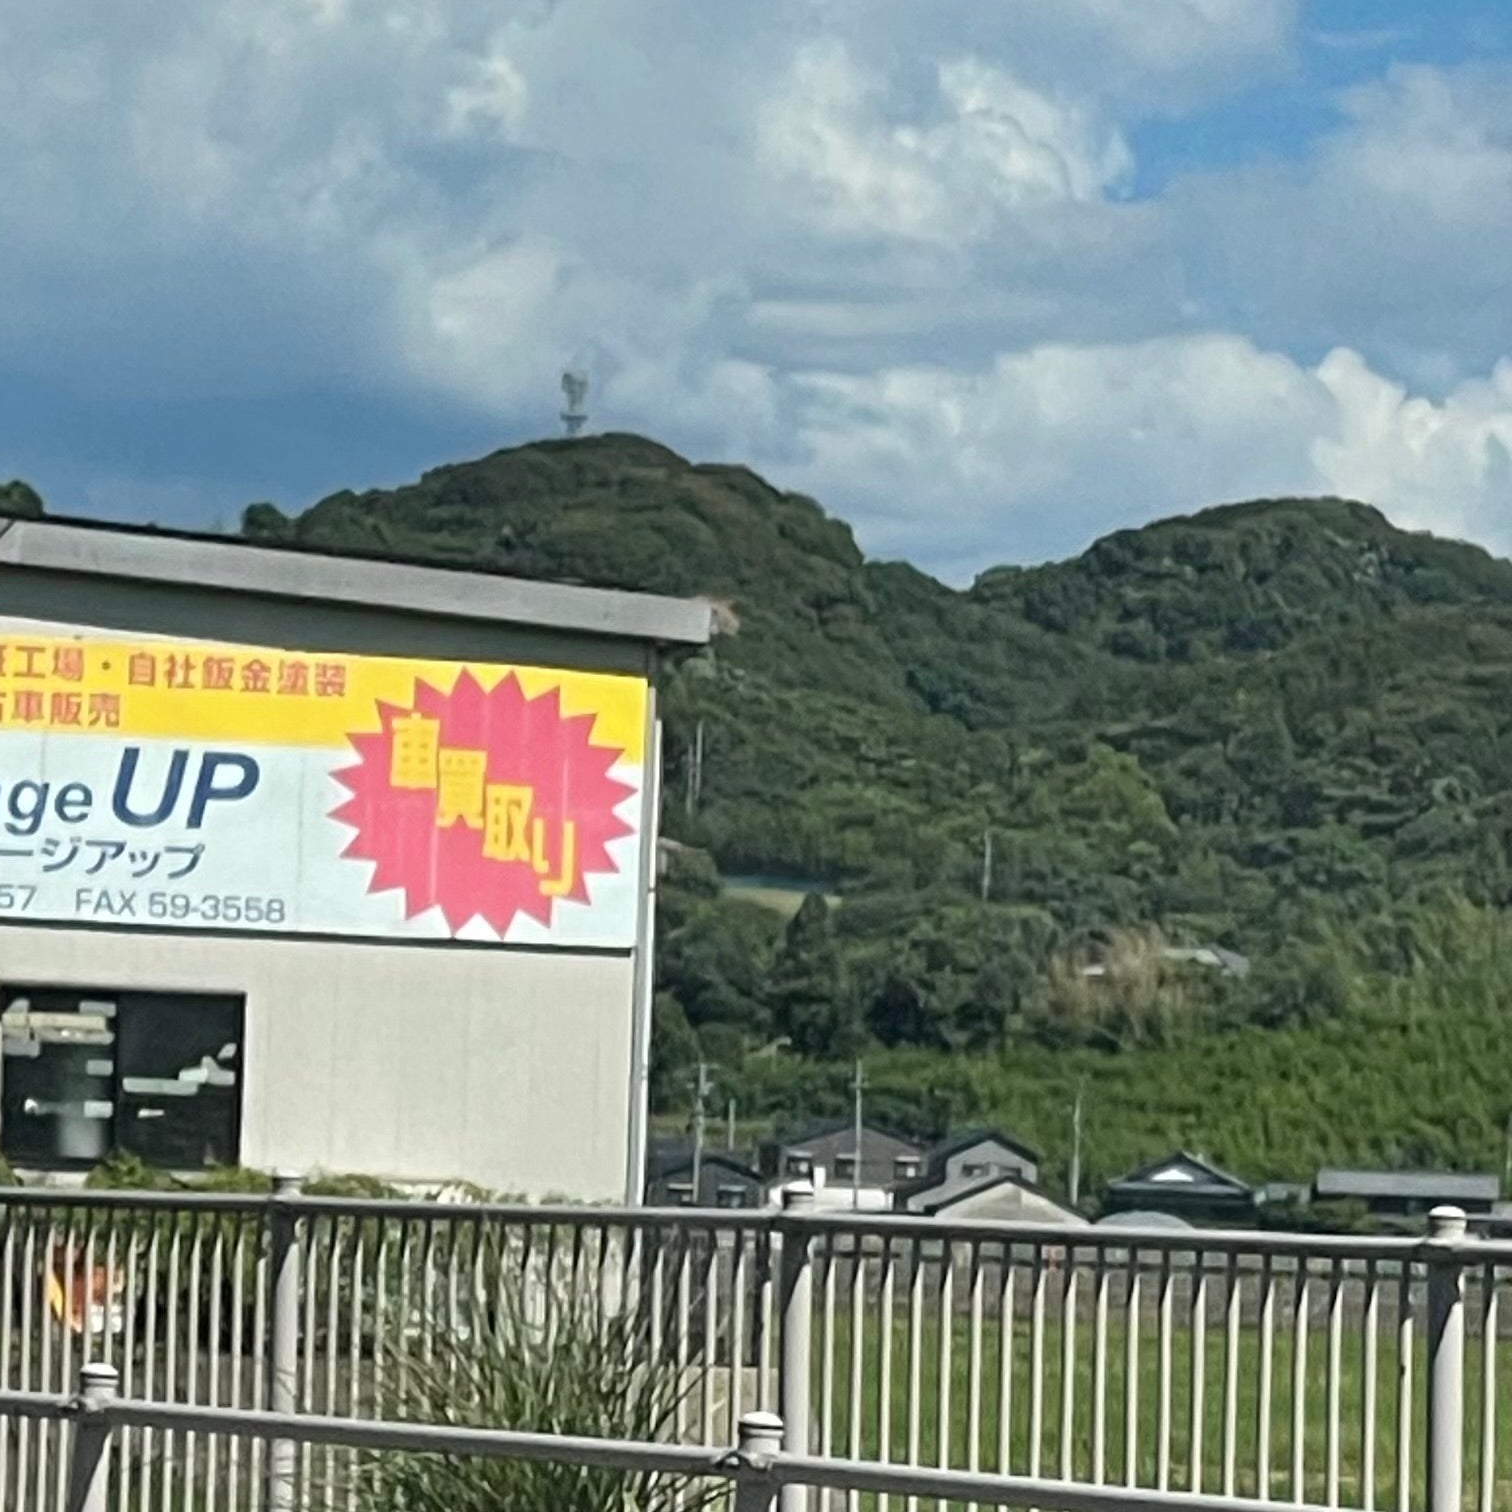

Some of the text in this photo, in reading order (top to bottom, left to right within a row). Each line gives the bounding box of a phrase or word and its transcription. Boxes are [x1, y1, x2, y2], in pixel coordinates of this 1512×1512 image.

[111, 746, 261, 830] UP
[390, 712, 576, 897] 車買取り
[74, 888, 139, 918] FAX
